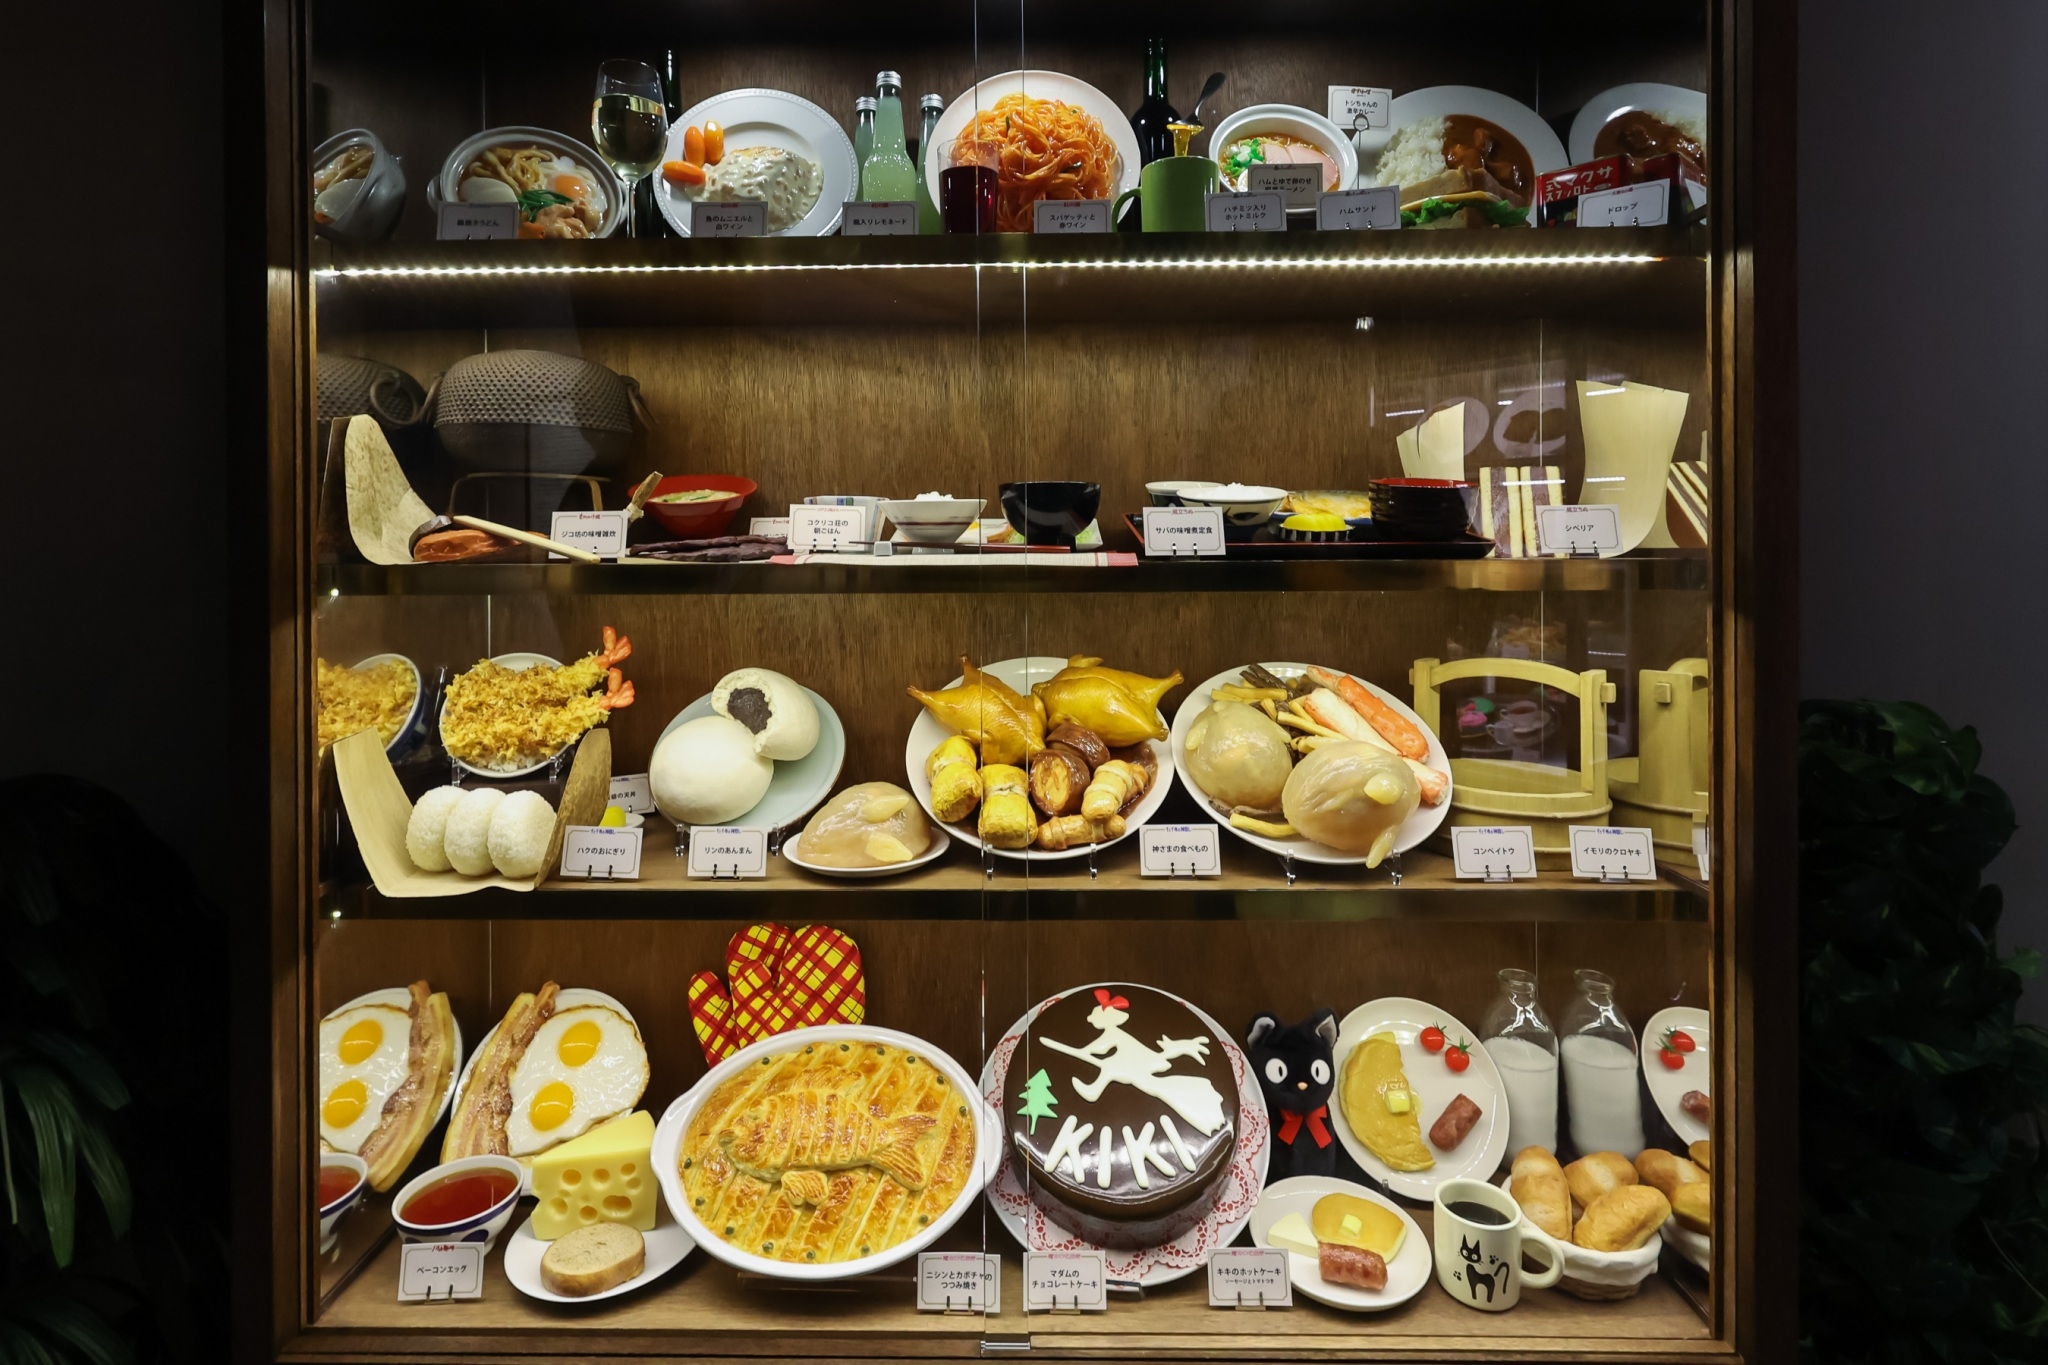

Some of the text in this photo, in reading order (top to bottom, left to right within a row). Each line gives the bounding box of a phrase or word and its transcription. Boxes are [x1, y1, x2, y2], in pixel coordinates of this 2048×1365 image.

[1340, 205, 1377, 214] ハムサンド
[1608, 202, 1639, 214] ドロップ
[813, 527, 841, 535] 朝ごはん
[1565, 524, 1594, 532] シベリア
[577, 847, 626, 855] ハクのおにぎり
[1152, 845, 1208, 853] 神さまの食べもの
[1583, 847, 1642, 856] イモリのクロヤキ
[1043, 1114, 1196, 1190] KIKI
[417, 1265, 467, 1274] ベーコンエッグ
[1050, 1269, 1080, 1278] マダムの
[1217, 1267, 1281, 1276] キキのホットケーキ
[926, 1271, 993, 1282] ニシンとカボチャの
[941, 1281, 977, 1290] つつみ焼き
[1032, 1280, 1098, 1289] チョコレートケーキ
